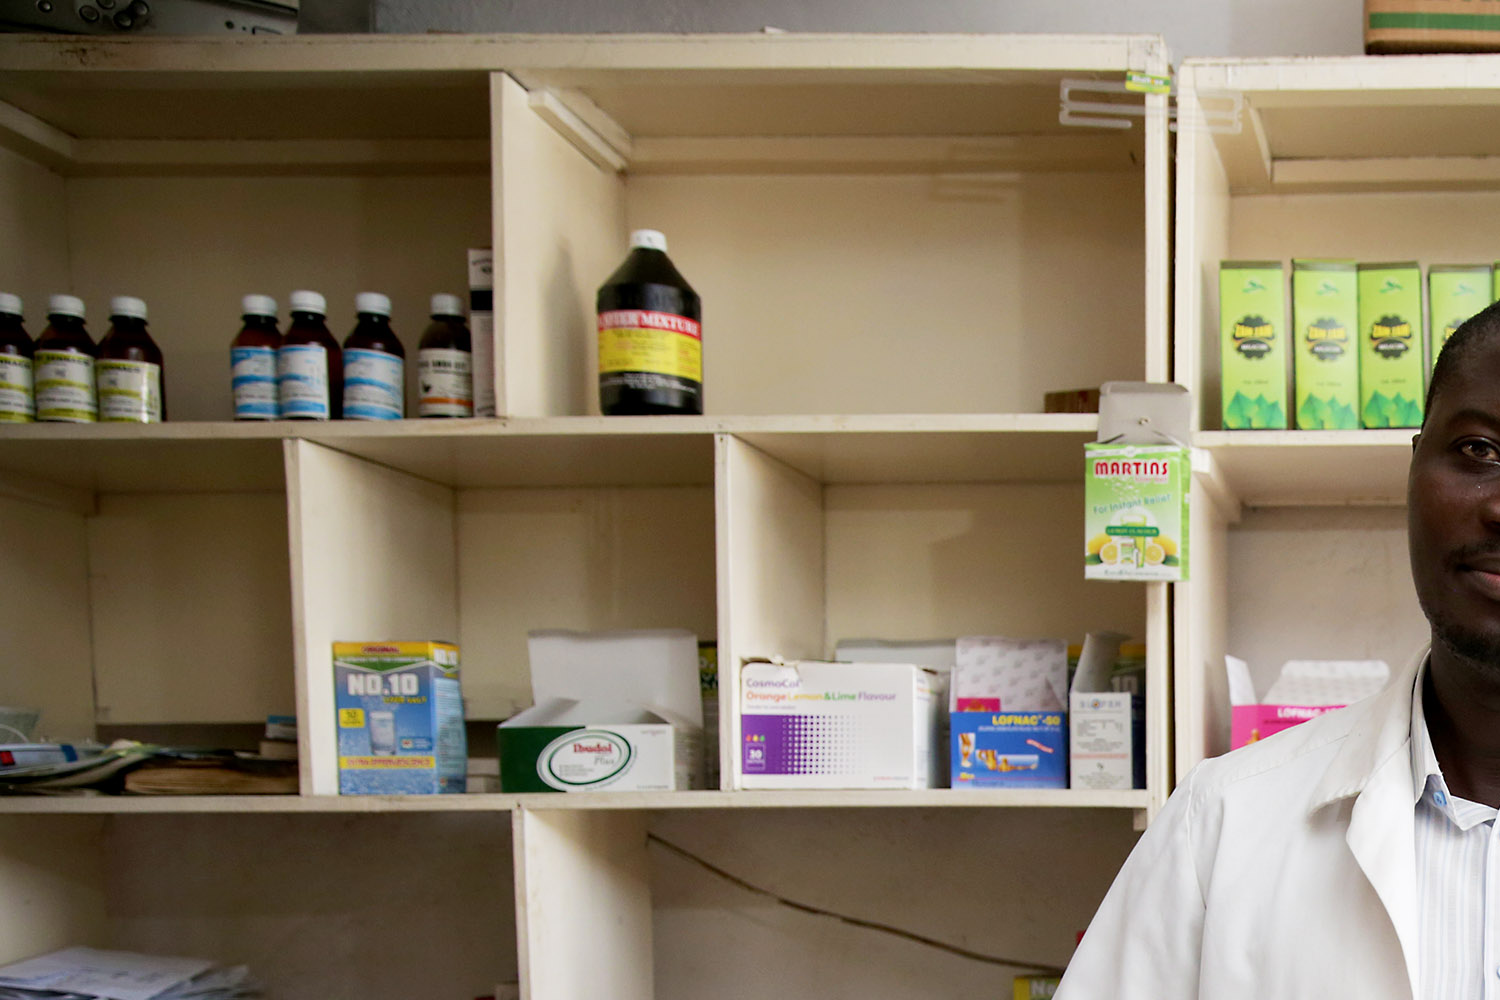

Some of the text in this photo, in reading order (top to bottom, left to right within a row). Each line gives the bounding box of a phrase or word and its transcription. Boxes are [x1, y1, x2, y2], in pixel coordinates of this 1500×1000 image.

[1094, 461, 1168, 475] MARTINS
[746, 691, 786, 703] Orange
[832, 691, 857, 701] Lime
[858, 691, 897, 701] Flavour
